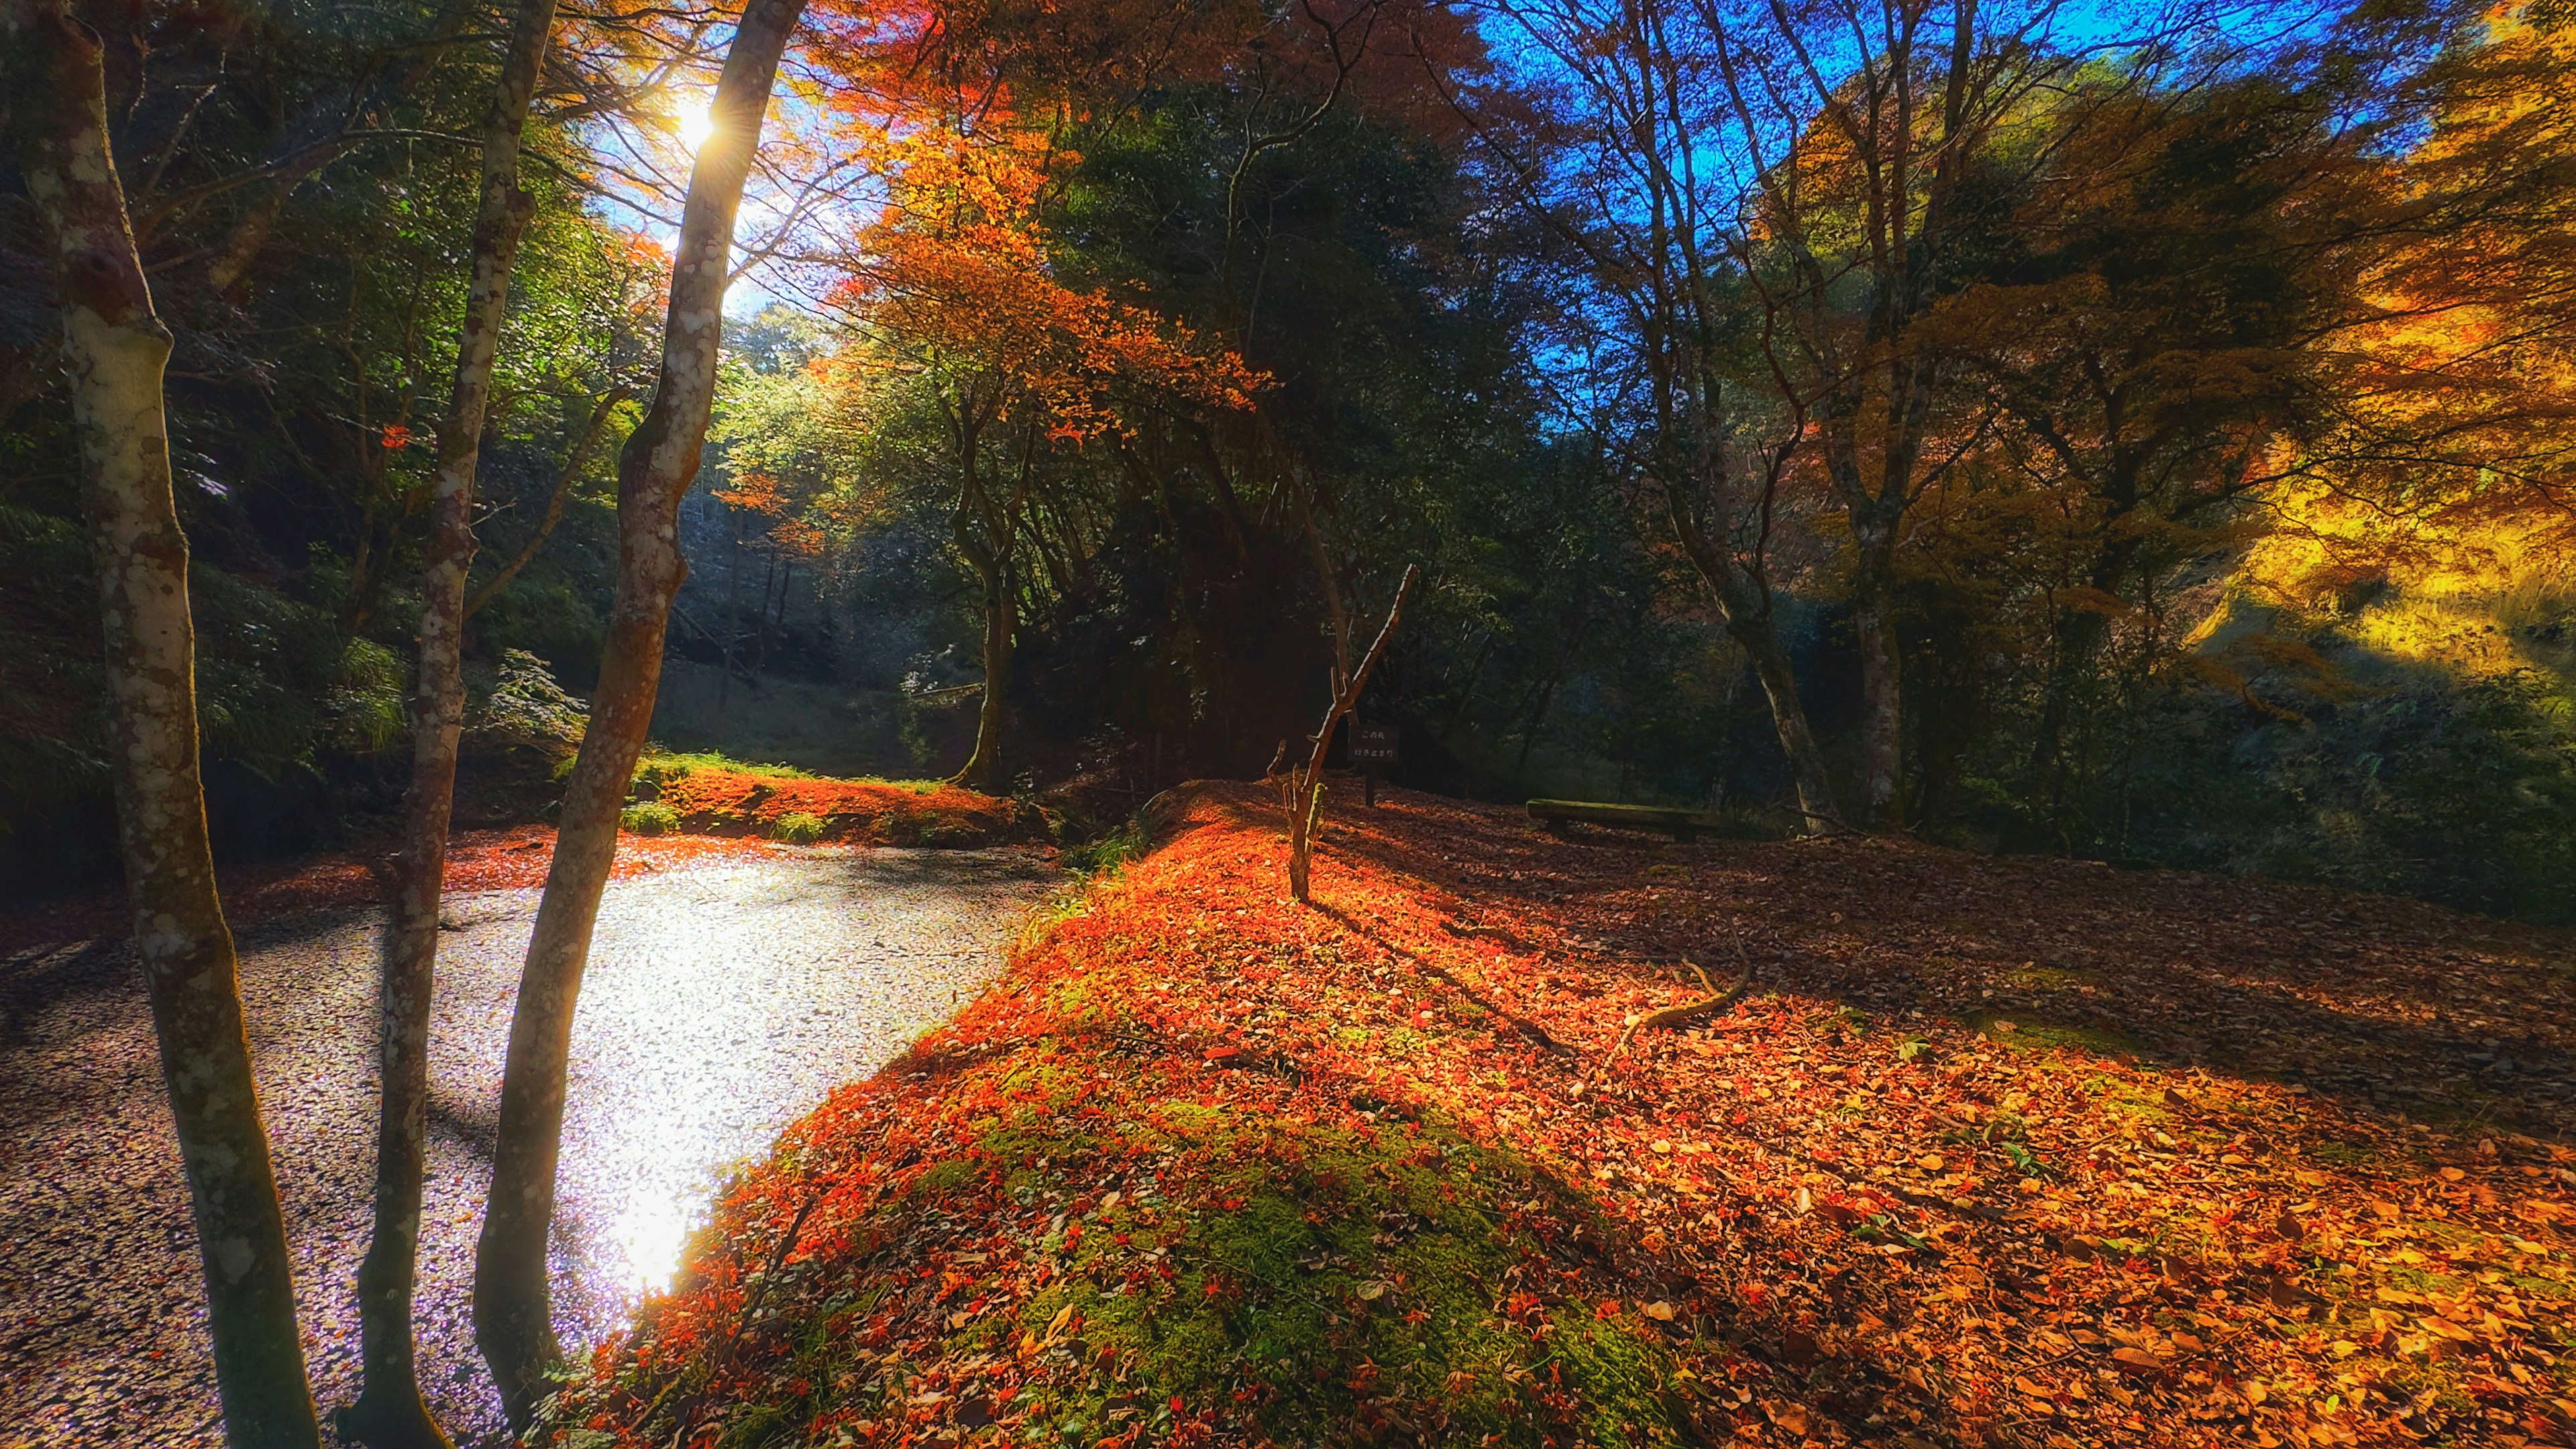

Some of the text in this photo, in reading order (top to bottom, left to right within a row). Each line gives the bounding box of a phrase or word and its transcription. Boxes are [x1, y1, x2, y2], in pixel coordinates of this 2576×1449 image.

[1362, 731, 1385, 739] この先
[1354, 749, 1393, 757] 行き止まり
